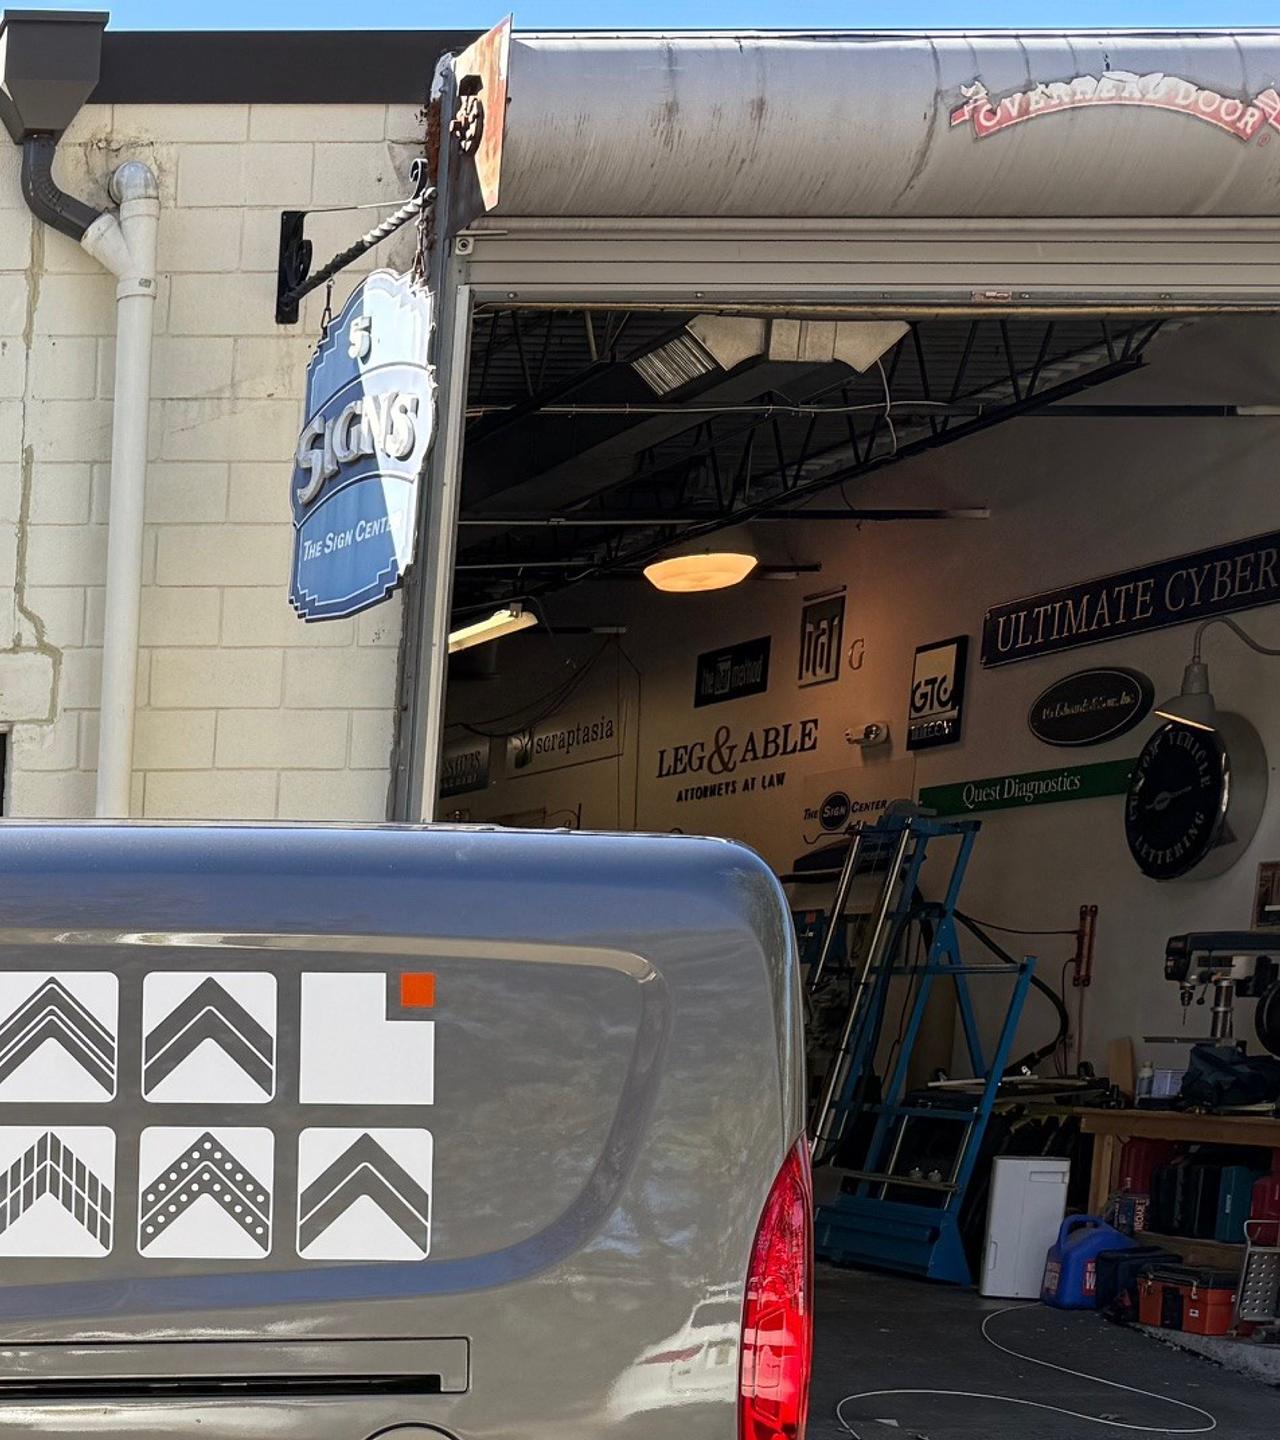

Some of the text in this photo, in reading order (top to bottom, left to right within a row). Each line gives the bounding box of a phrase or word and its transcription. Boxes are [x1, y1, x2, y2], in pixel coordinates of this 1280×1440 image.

[1176, 78, 1260, 134] DOOR
[348, 316, 372, 359] 5
[297, 391, 420, 503] SIGNS
[303, 540, 323, 561] THE
[324, 532, 354, 554] SIGN
[997, 548, 1280, 652] ULTIMATE CYBER
[535, 715, 614, 755] scraptasia
[676, 772, 787, 803] ATTORNEYS AT LAW
[962, 772, 1081, 809] Quest Diagnostics
[1134, 811, 1206, 866] LETTERING
